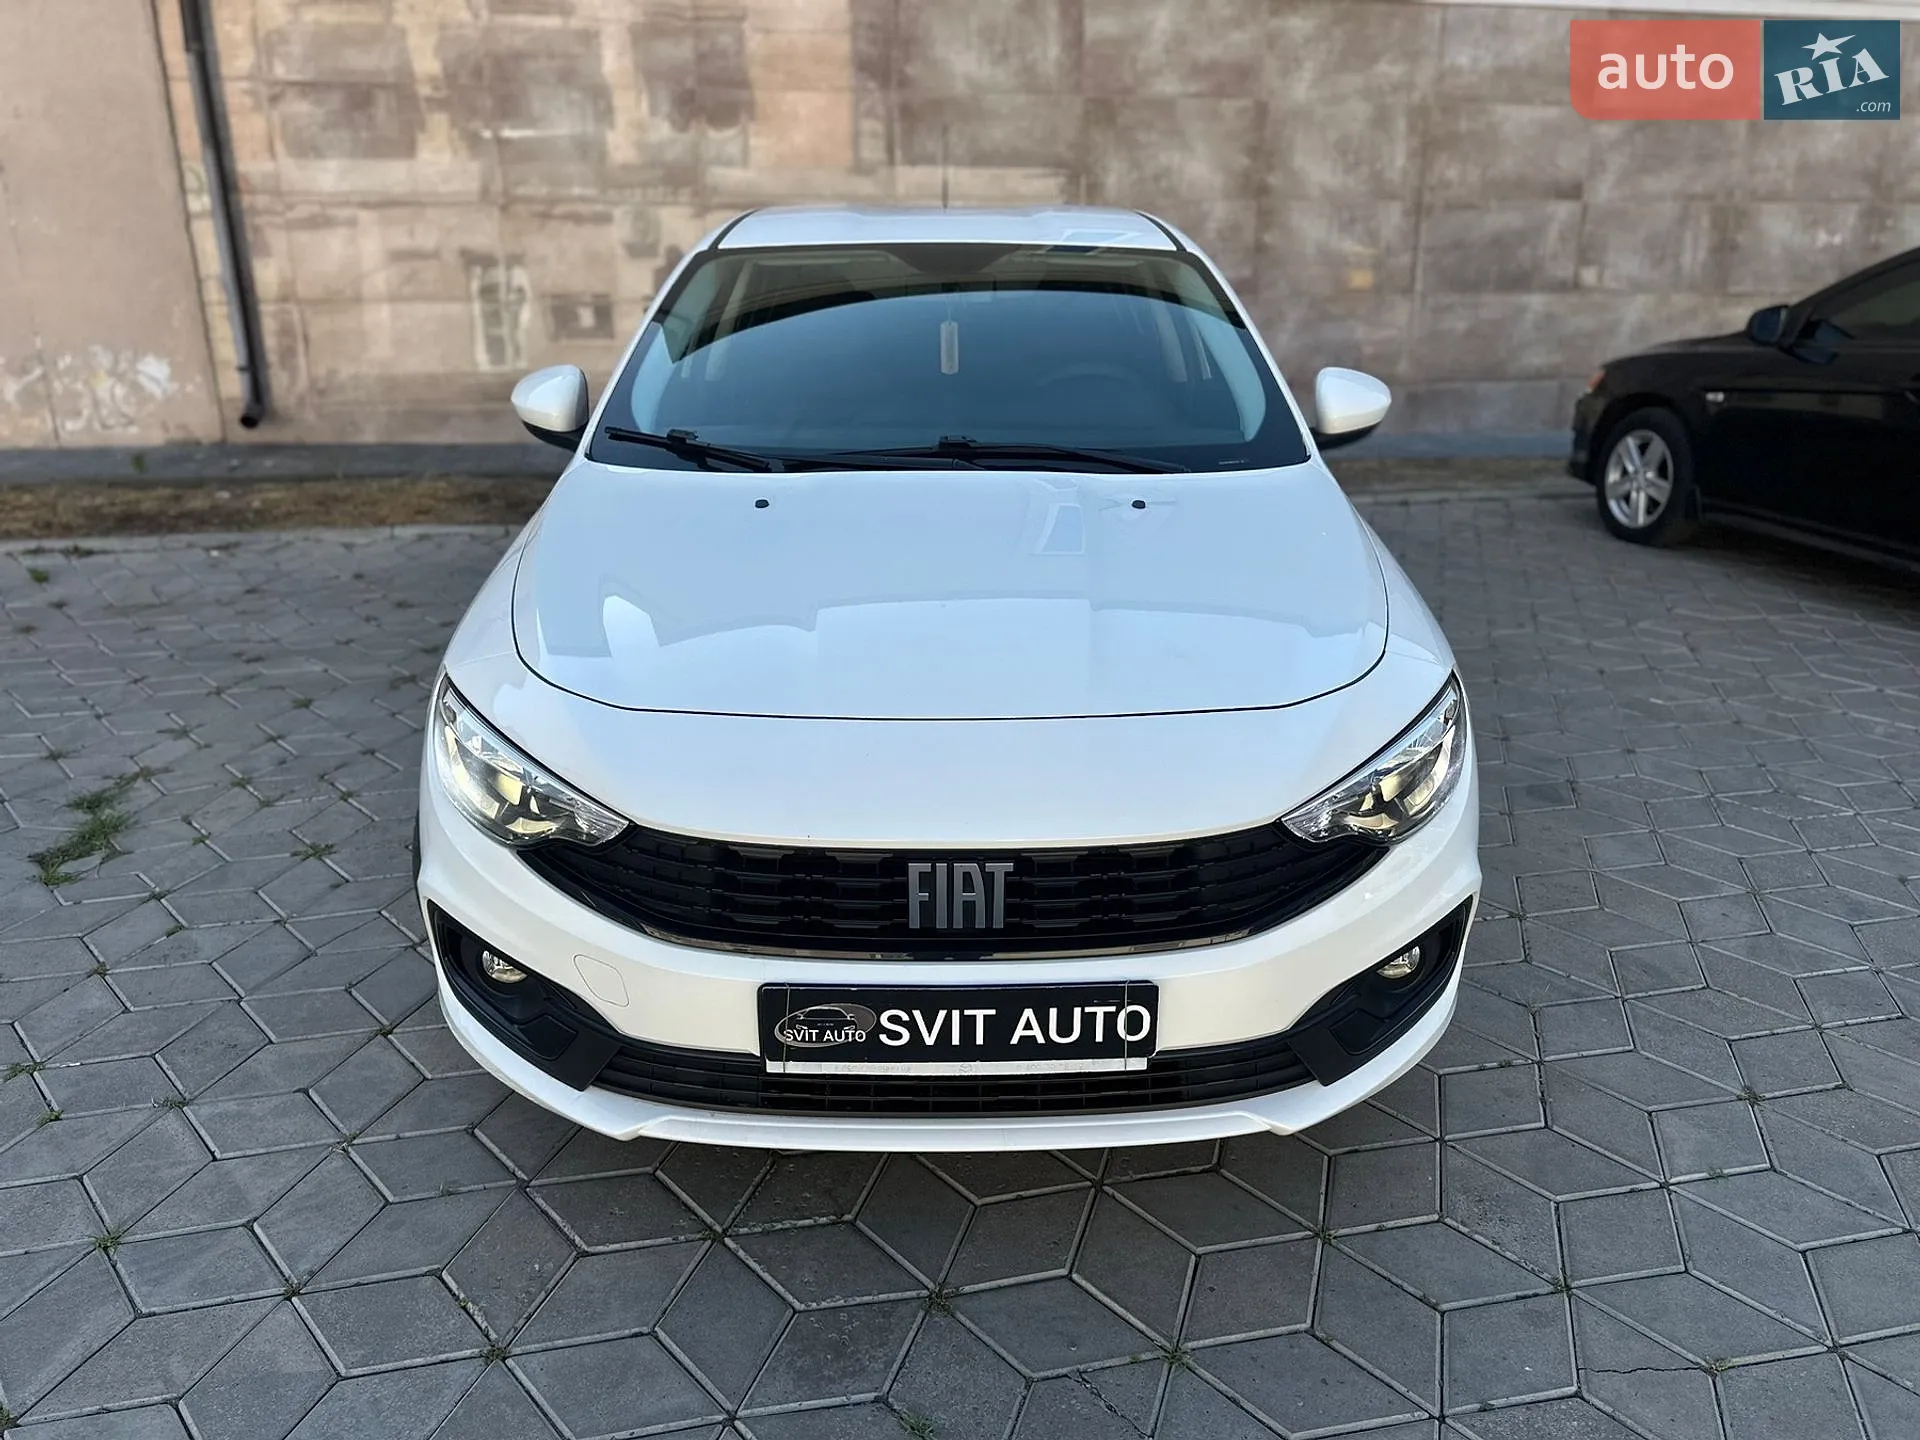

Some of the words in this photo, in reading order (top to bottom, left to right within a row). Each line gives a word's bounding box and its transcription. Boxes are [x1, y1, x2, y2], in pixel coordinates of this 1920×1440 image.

[908, 862, 1014, 929] FIAT
[784, 1029, 820, 1042] SVIT
[823, 1030, 866, 1043] AUTO
[879, 1009, 997, 1046] SVIT
[1010, 1004, 1150, 1044] AUTO
